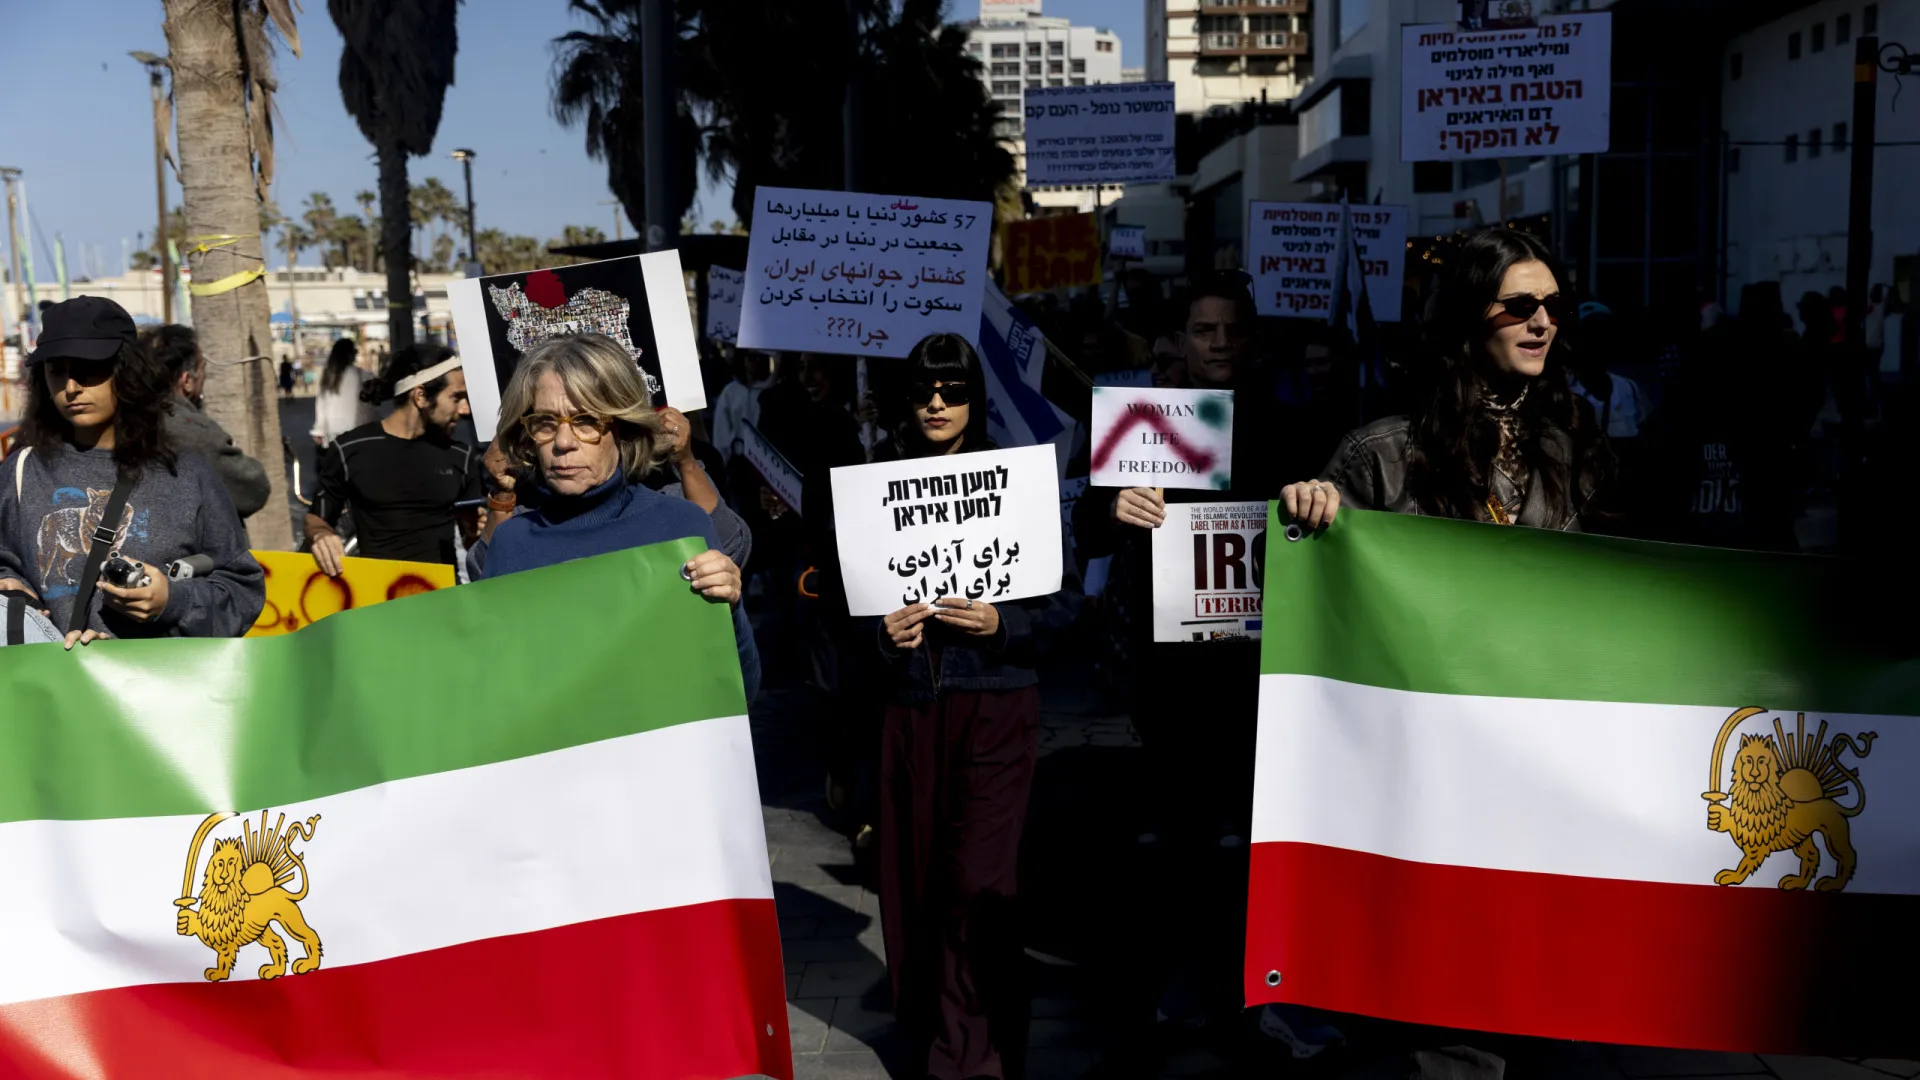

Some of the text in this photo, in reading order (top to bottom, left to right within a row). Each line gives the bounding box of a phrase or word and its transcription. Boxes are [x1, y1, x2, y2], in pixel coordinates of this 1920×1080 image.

[1562, 23, 1582, 37] 57
[1431, 42, 1569, 63] ומיליארדי מוסלמים
[1446, 63, 1554, 81] ואף מילה לגינוי
[1418, 80, 1582, 112] הטבח באיראן
[1025, 105, 1045, 120] קם
[1049, 104, 1078, 117] העם
[1091, 100, 1120, 115] נופל
[1125, 100, 1174, 113] המשטר
[1446, 106, 1553, 125] דם האיראנים
[1440, 122, 1560, 153] לא הפקר!
[766, 201, 977, 230] 57 کشور دنیا با میلیاردها
[1263, 208, 1322, 222] מוסלמיות
[1374, 212, 1391, 225] 57
[1008, 214, 1094, 254] FREE
[1272, 222, 1320, 237] מוסלמים
[771, 227, 963, 257] جمعیت در دنیا در مقابل
[1283, 240, 1335, 254] ילה לגינוי
[1006, 252, 1098, 292] IRAN
[1261, 255, 1325, 275] באיראן
[820, 262, 902, 288] جوانهای
[907, 266, 966, 289] کشتار
[1282, 276, 1331, 290] איראנים
[759, 288, 963, 316] سکوت را انتخاب کردن
[1127, 403, 1195, 417] WOMAN
[1142, 432, 1180, 445] LIFE
[1118, 460, 1201, 474] FREEDOM
[882, 465, 1008, 507] למען החירות,
[893, 492, 1001, 531] למען איראן
[1190, 520, 1210, 531] LABEL
[1211, 520, 1229, 530] THEM
[1230, 520, 1240, 530] AS
[1240, 520, 1246, 529] A
[888, 537, 1020, 577] برای آزادی،
[902, 569, 1011, 606] برای ایران
